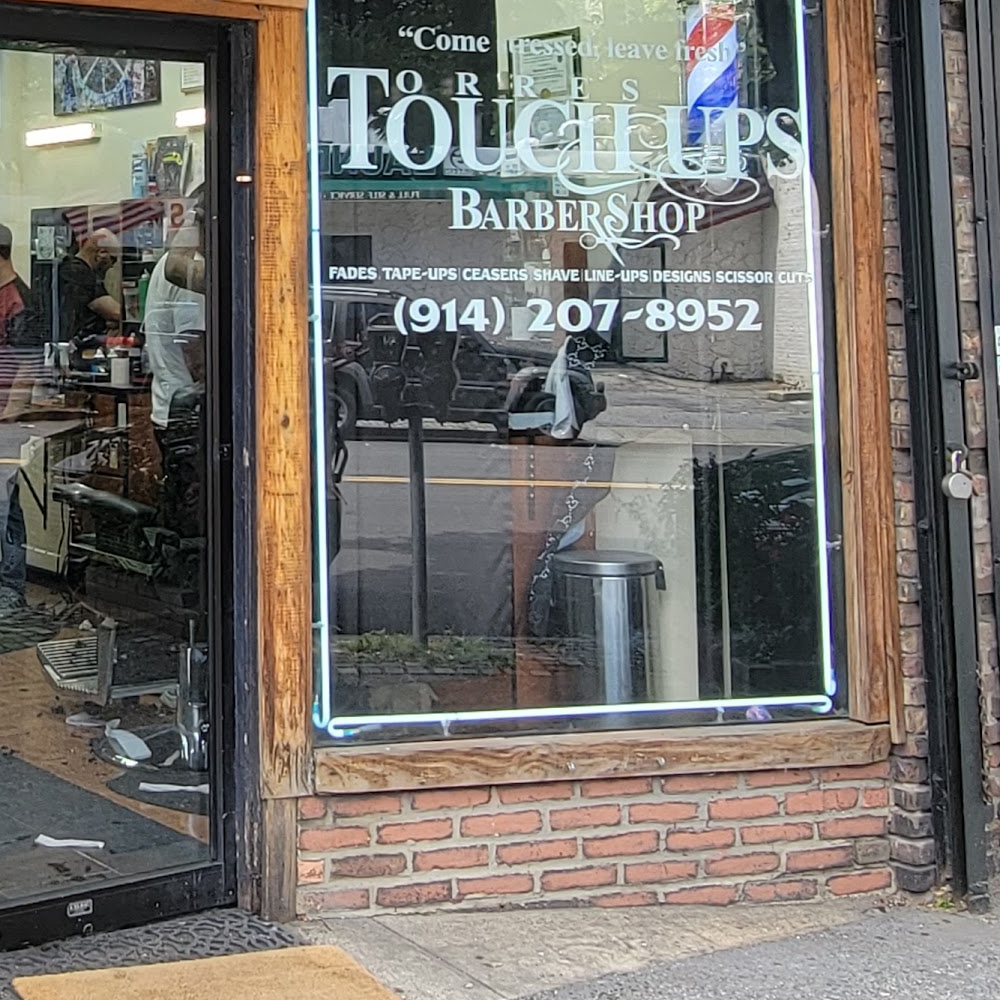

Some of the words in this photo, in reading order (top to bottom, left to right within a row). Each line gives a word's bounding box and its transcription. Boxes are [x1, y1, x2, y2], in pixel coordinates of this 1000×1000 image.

[607, 37, 668, 60] leave
[327, 66, 637, 174] TOUCH
[661, 104, 805, 180] UPS
[329, 266, 377, 280] FADES
[382, 267, 458, 281] TAPE-UPS
[463, 267, 528, 281] CEASERS
[533, 268, 580, 282] SHAVE
[584, 269, 649, 283] LINE-UPS
[653, 270, 711, 284] DESIGNS
[716, 271, 774, 285] SCISSOR
[394, 297, 505, 336] (914)
[526, 298, 763, 333] 207-8952
